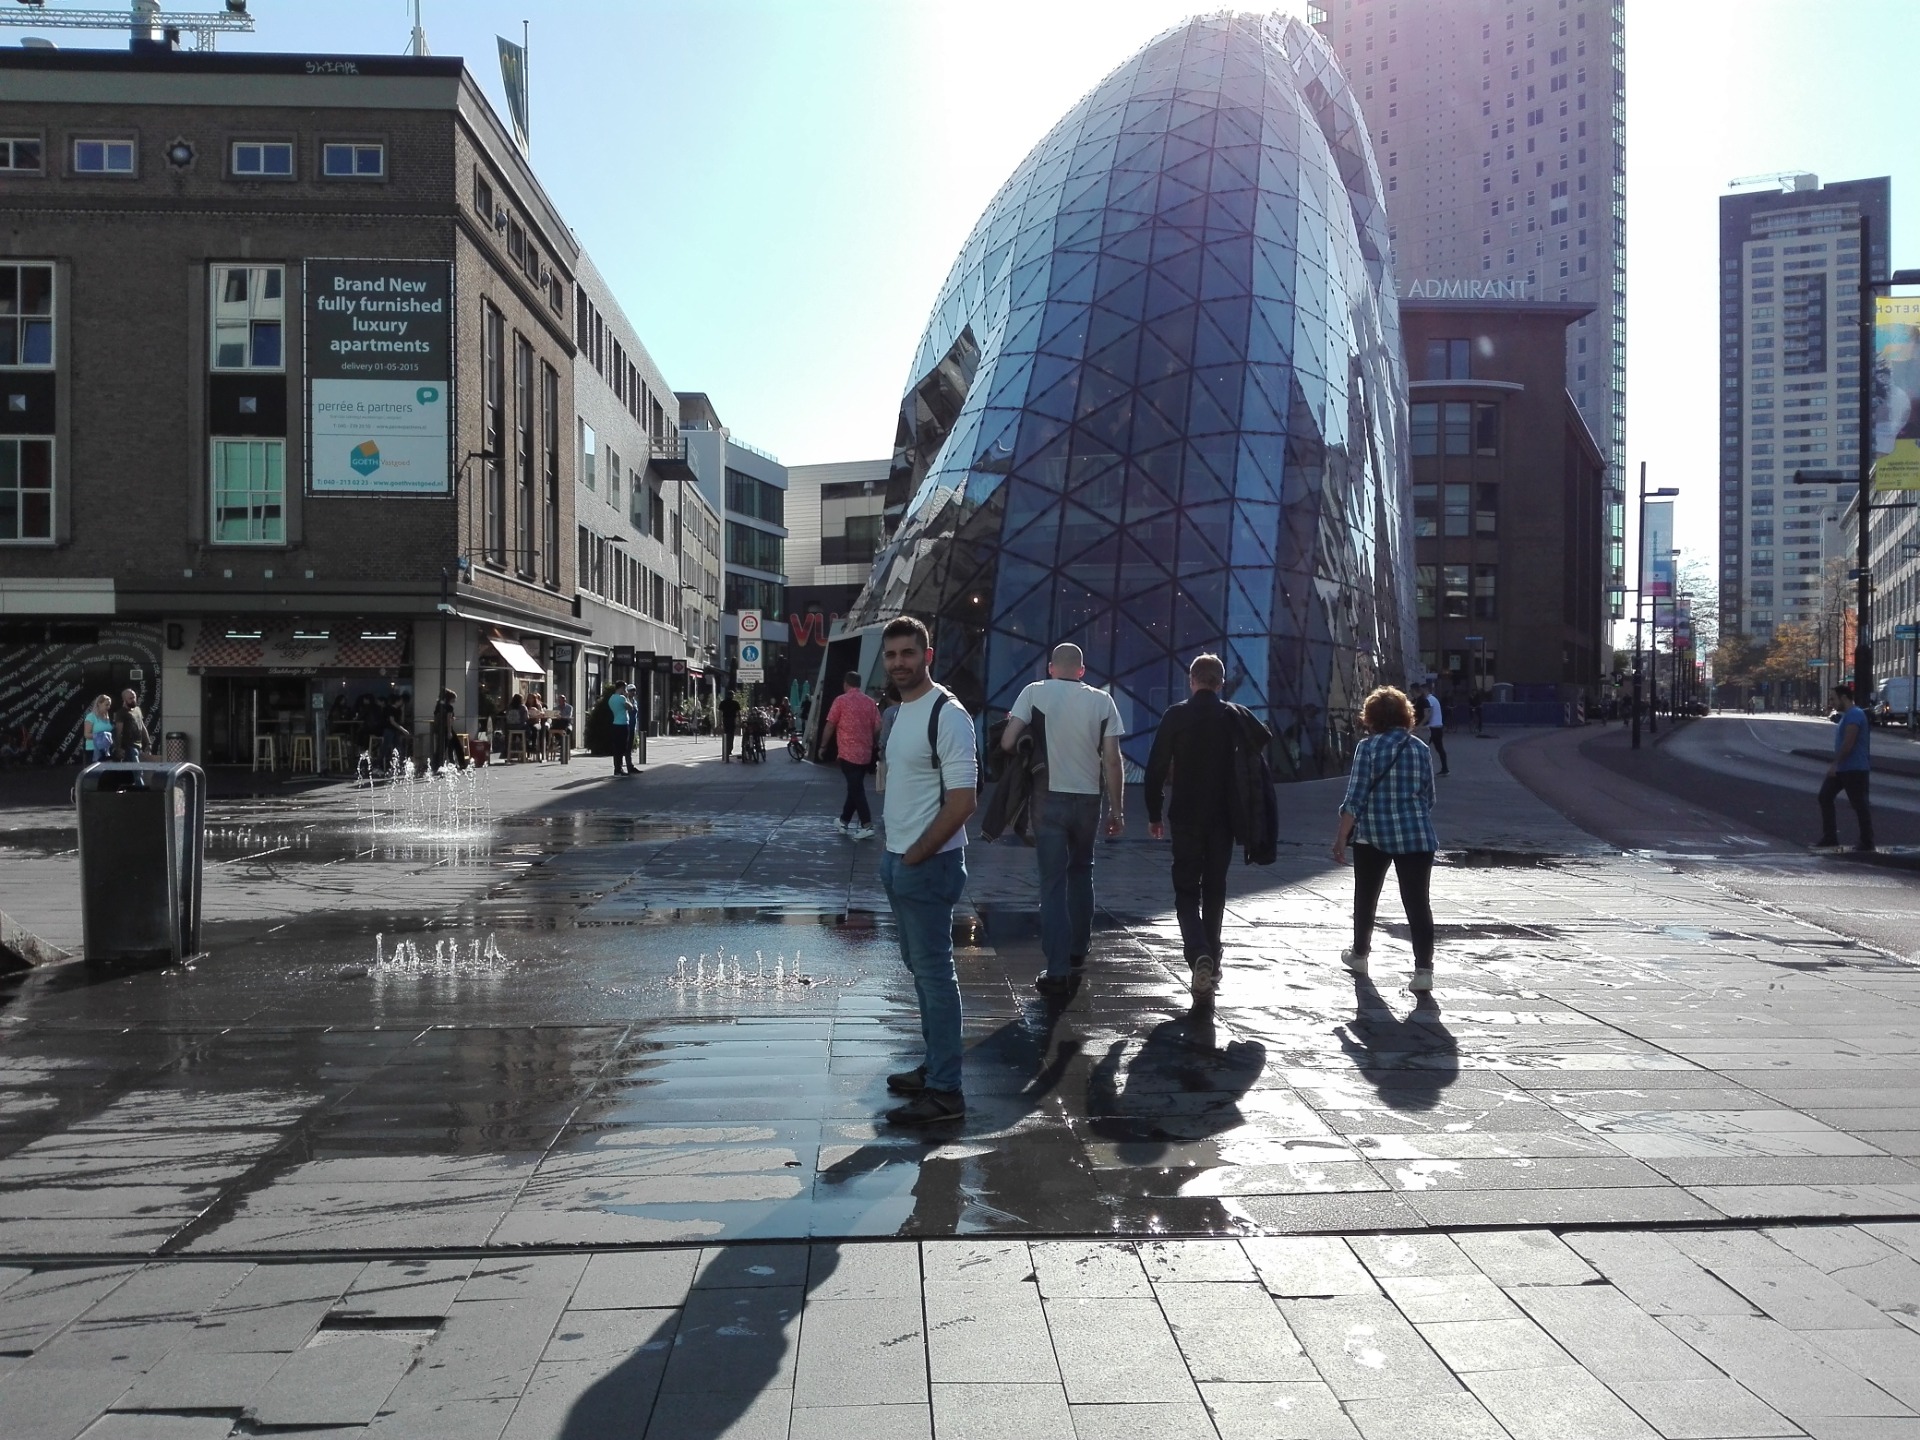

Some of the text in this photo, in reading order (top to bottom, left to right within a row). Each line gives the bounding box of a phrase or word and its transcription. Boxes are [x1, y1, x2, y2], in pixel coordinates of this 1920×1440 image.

[334, 276, 426, 293] Brand New
[1408, 278, 1529, 299] ADMIRANT
[317, 296, 442, 314] fully furnished
[353, 317, 408, 335] luxury
[330, 338, 430, 353] apartments
[341, 361, 419, 372] delivery 01-05-2015
[318, 400, 413, 414] perrée & partners
[352, 458, 410, 468] GOETH Vastgoed
[790, 612, 848, 647] VU
